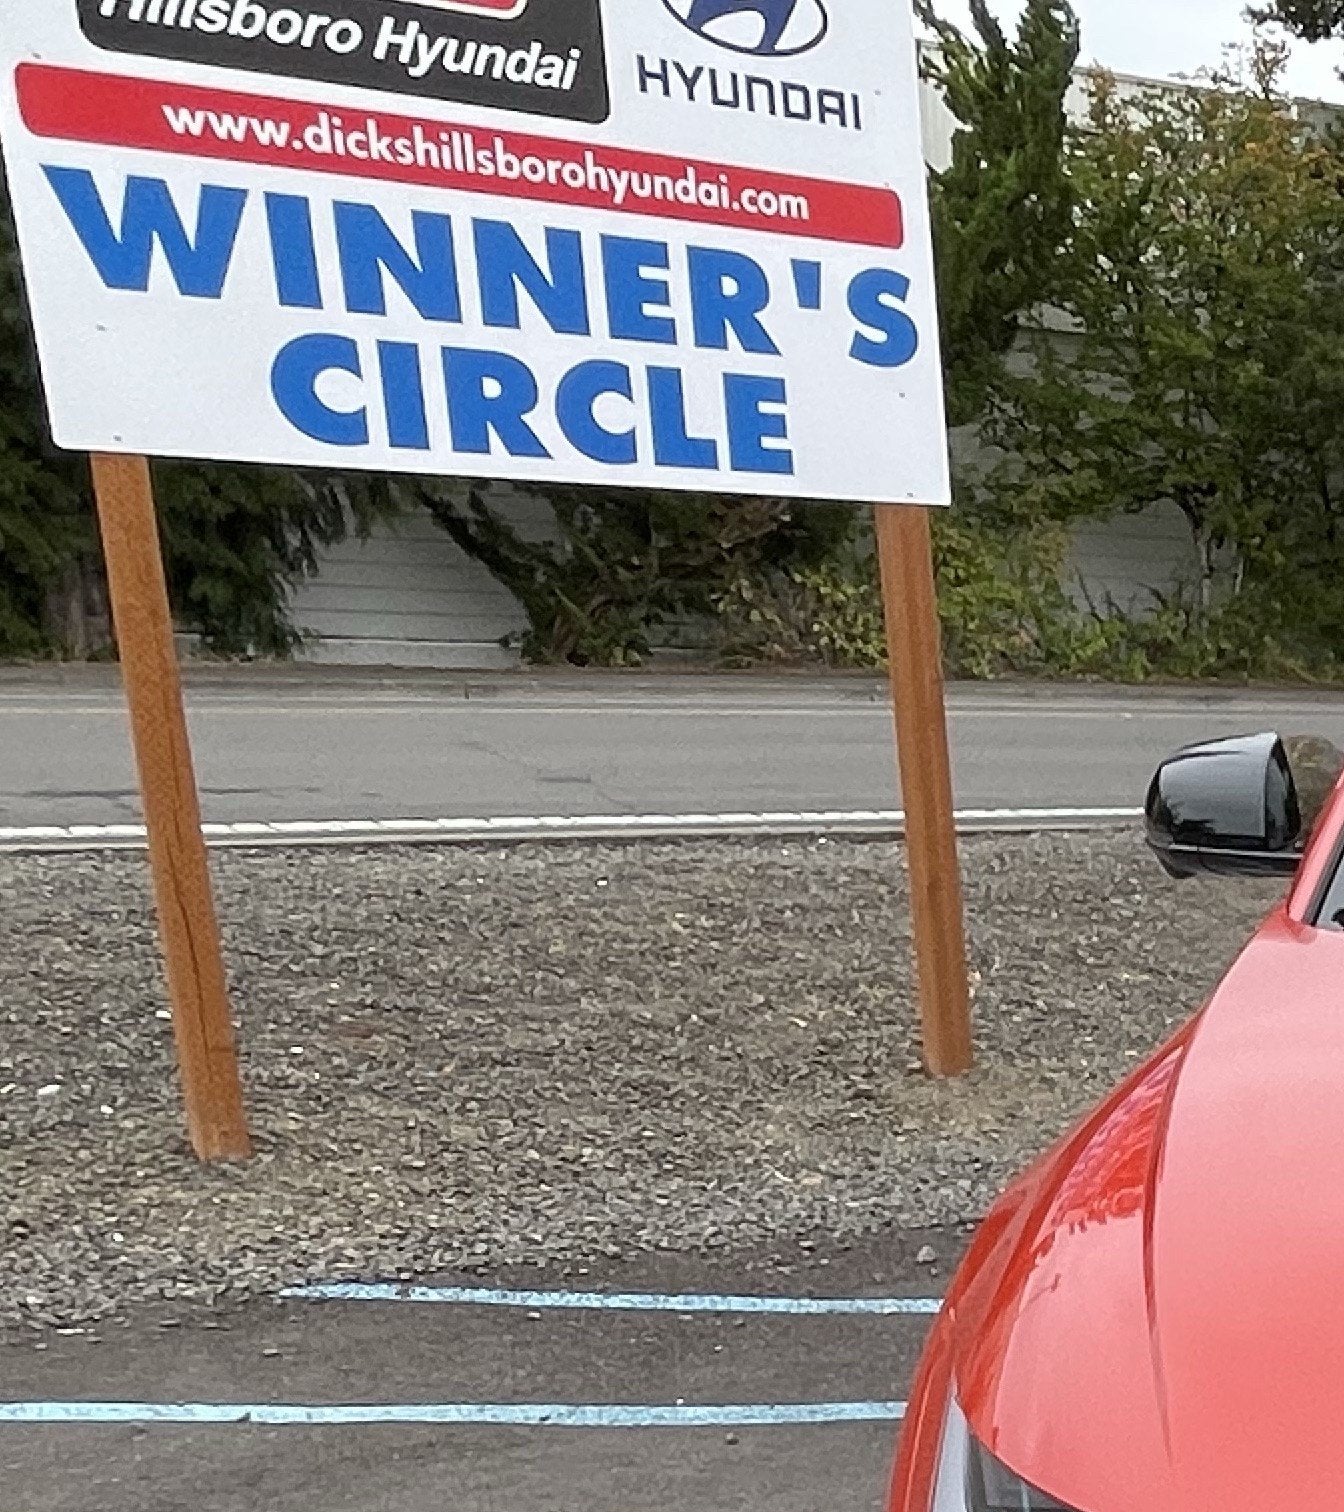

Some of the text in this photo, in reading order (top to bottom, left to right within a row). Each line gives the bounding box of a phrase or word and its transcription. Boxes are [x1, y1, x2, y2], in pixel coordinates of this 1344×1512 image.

[372, 15, 581, 90] Hyundai
[636, 54, 862, 131] HYUNDAI
[162, 103, 810, 221] www.dickshillsborohyundai.com
[40, 163, 920, 369] WINNER'S
[269, 332, 795, 477] CIRCLE
